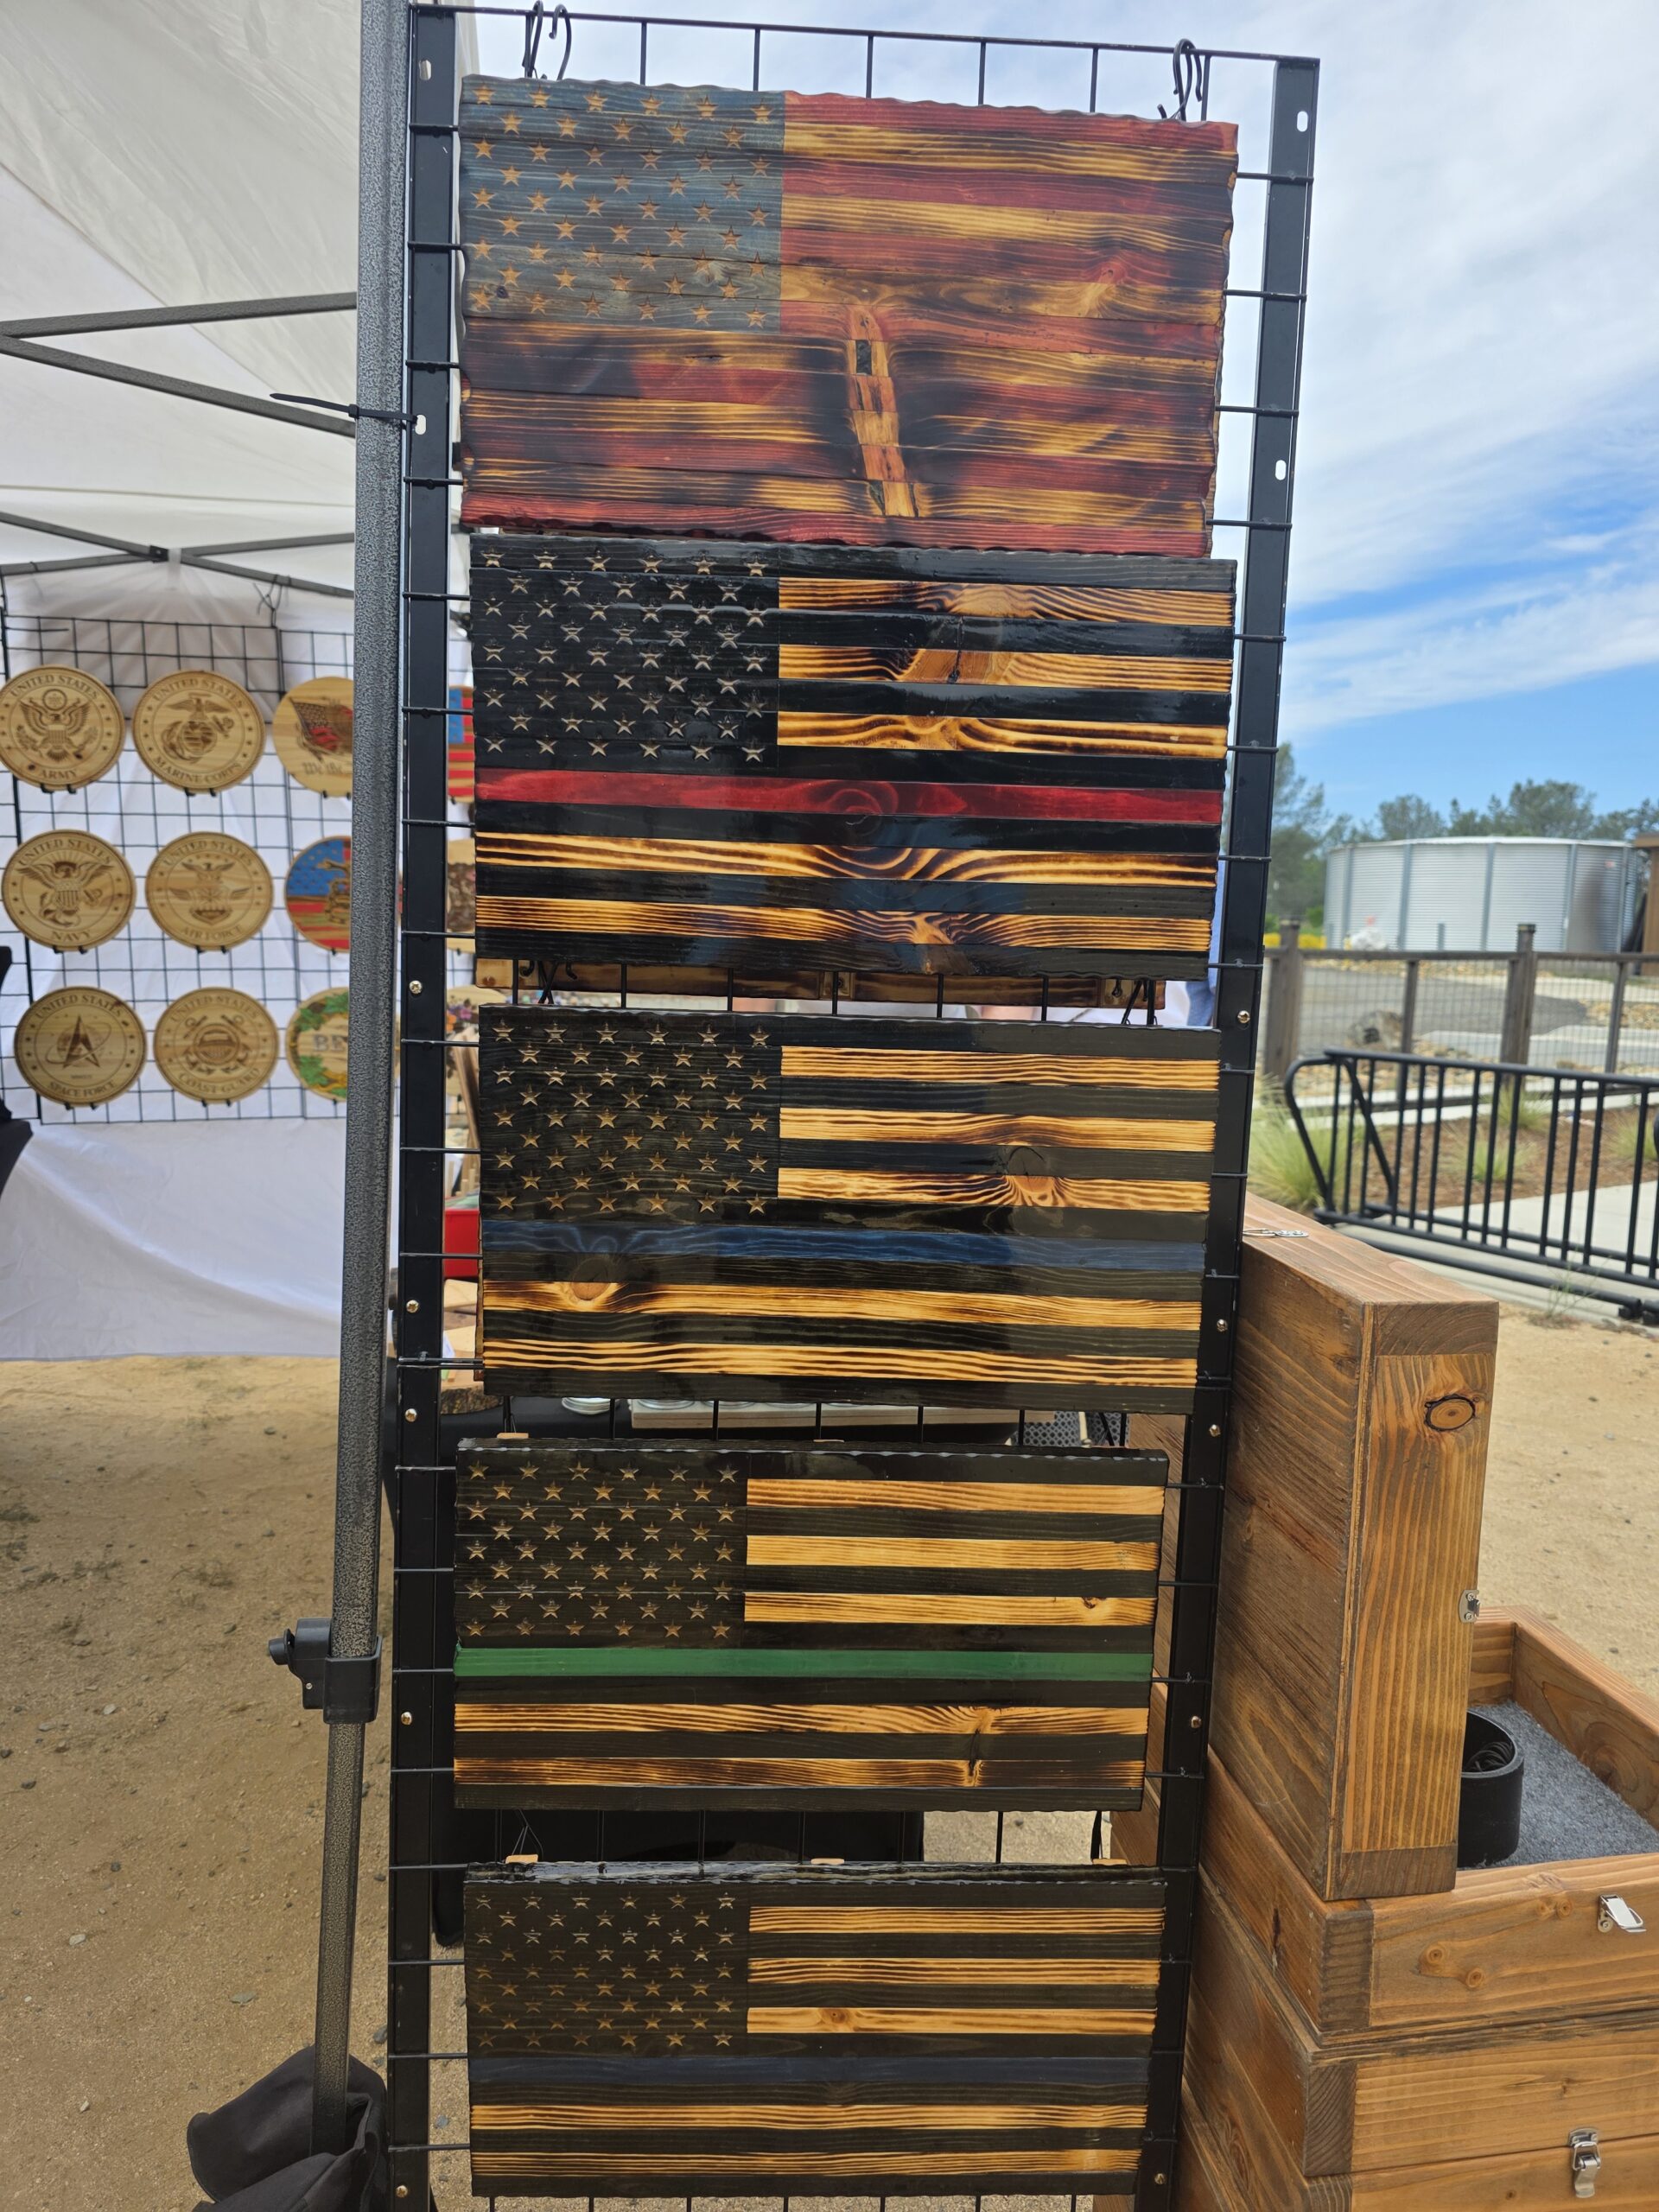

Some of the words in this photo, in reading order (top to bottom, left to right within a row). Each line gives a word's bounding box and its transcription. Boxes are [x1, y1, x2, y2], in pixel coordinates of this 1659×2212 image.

[10, 674, 54, 697] UNITED
[57, 675, 99, 700] STATES
[153, 678, 199, 702] UNITED
[201, 679, 243, 709] STATES
[41, 768, 77, 779] ARMY
[154, 756, 201, 783] MARINE
[204, 762, 243, 784] CORPS
[18, 838, 63, 866] UNITED
[67, 839, 111, 864] STATES
[162, 841, 207, 866] UNITED
[212, 841, 252, 866] STATES
[52, 930, 91, 942] NAVY
[35, 994, 79, 1020] UNITED
[82, 995, 122, 1018] STATES
[170, 995, 213, 1021] UNITED
[216, 995, 257, 1019] STATES
[49, 1080, 79, 1097] SPACE
[82, 1079, 116, 1097] FORCE
[178, 1073, 217, 1094] COAST
[221, 1067, 260, 1094] GUARD
